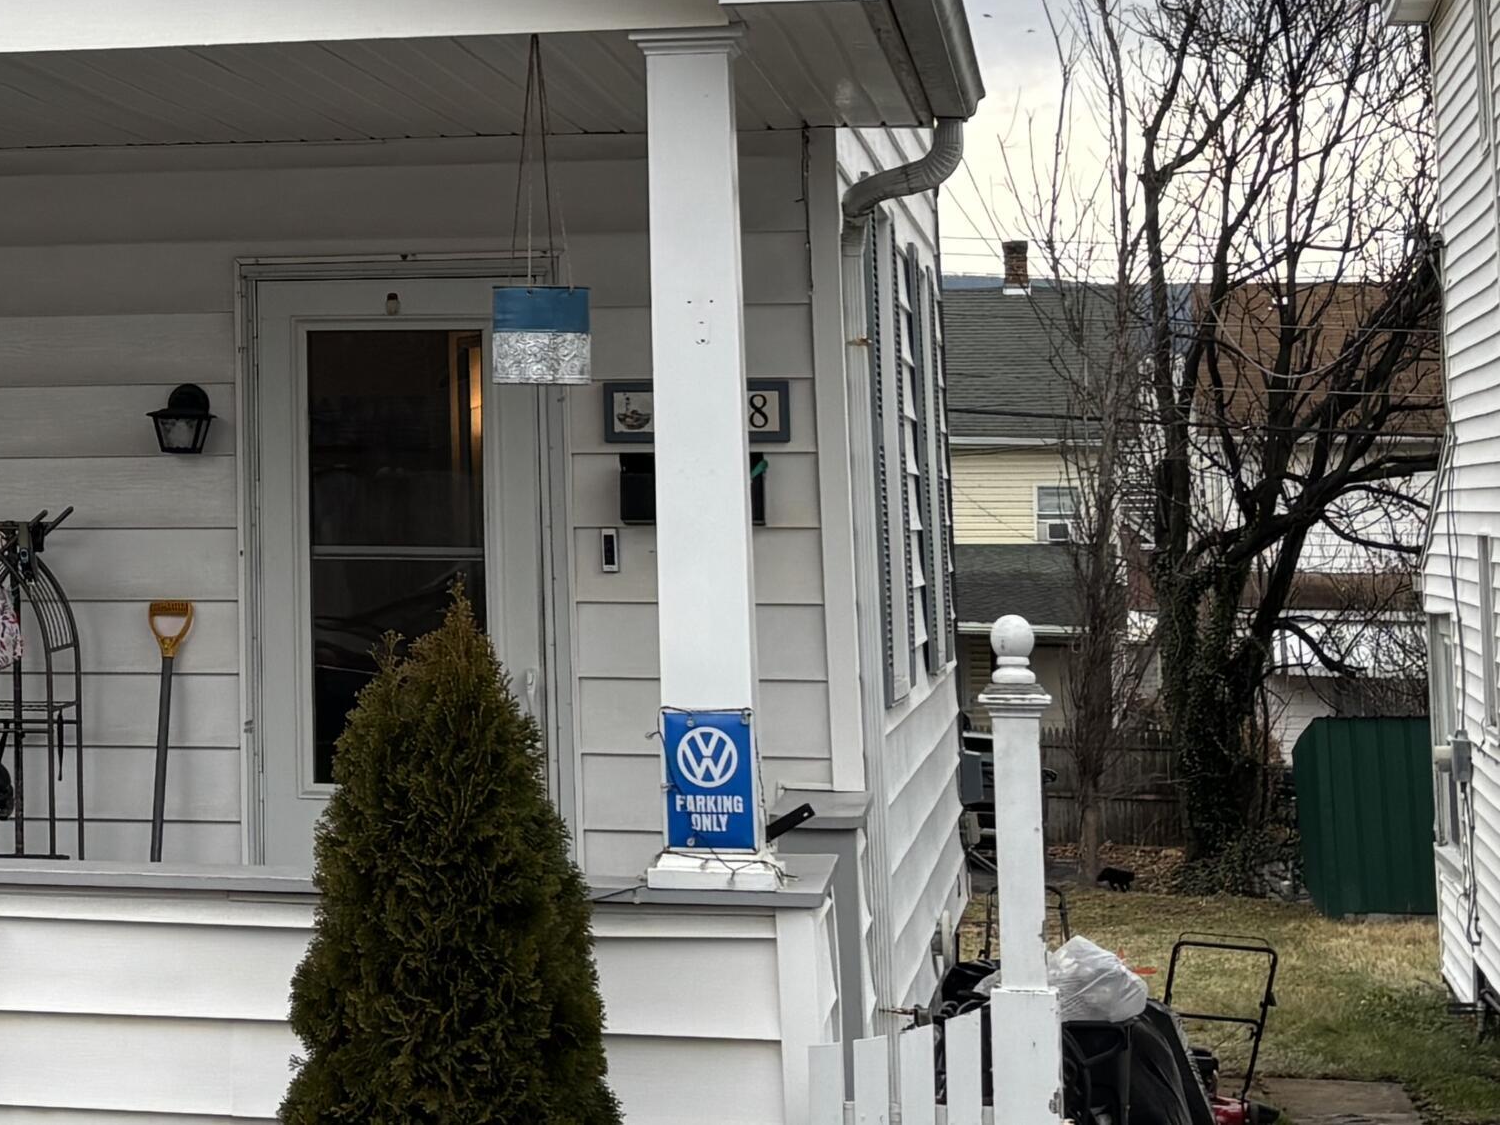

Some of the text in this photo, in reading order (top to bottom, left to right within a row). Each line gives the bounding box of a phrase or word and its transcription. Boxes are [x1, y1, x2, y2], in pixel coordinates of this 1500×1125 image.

[749, 393, 769, 429] 8
[675, 794, 744, 814] PARKING
[691, 813, 729, 832] ONLY
